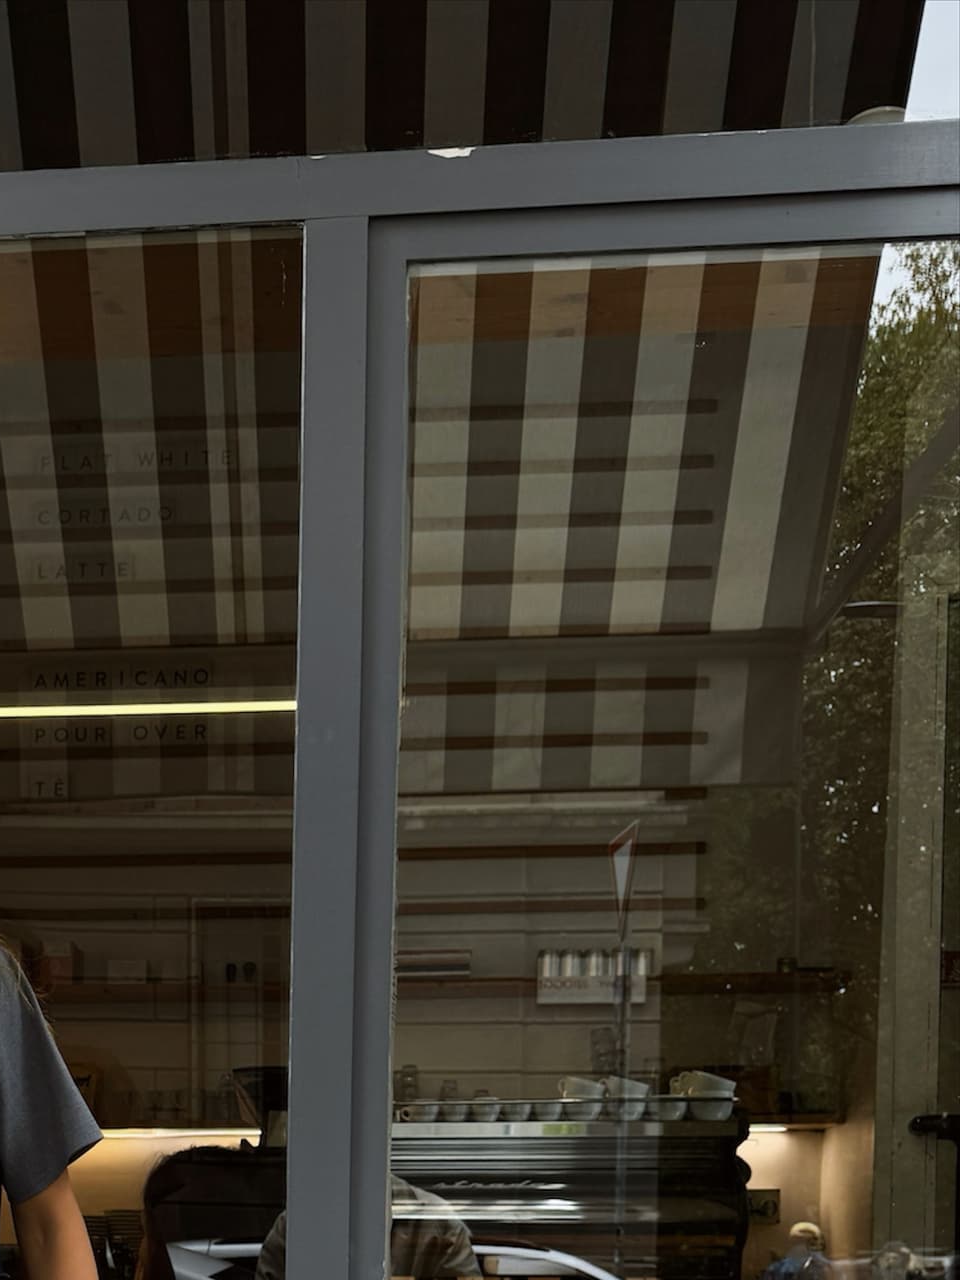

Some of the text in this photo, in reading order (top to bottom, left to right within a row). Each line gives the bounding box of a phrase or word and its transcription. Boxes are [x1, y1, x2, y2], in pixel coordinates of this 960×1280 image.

[41, 450, 232, 471] FLAT WHITE
[37, 507, 173, 525] CORTADO
[37, 562, 130, 579] LATTE
[34, 667, 210, 689] AMERICANO
[34, 722, 208, 743] POUR OVER
